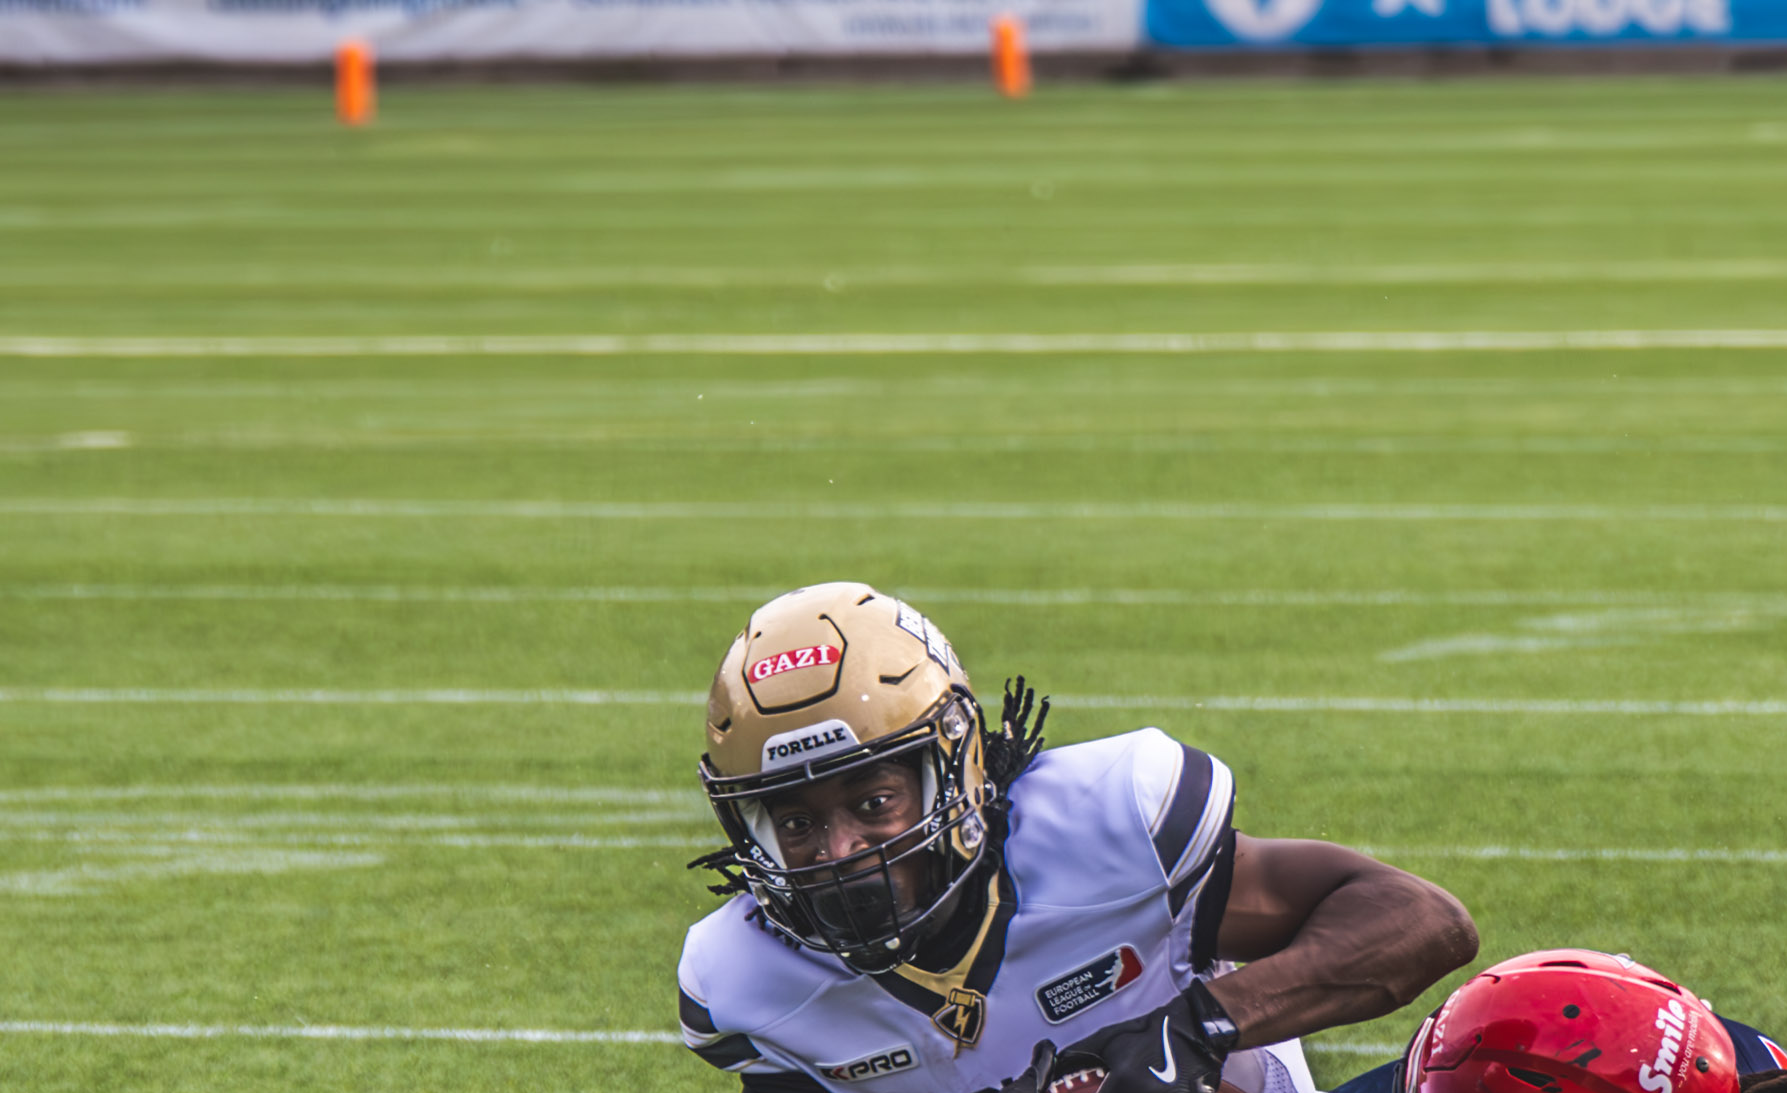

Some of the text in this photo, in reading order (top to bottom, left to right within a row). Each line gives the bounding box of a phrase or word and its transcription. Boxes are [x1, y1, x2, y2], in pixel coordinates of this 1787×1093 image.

[767, 727, 847, 761] FORELLE
[1044, 970, 1094, 999] EUROPEAN
[1049, 986, 1083, 1008] LEAGUE
[1053, 988, 1101, 1016] FOOTBALL
